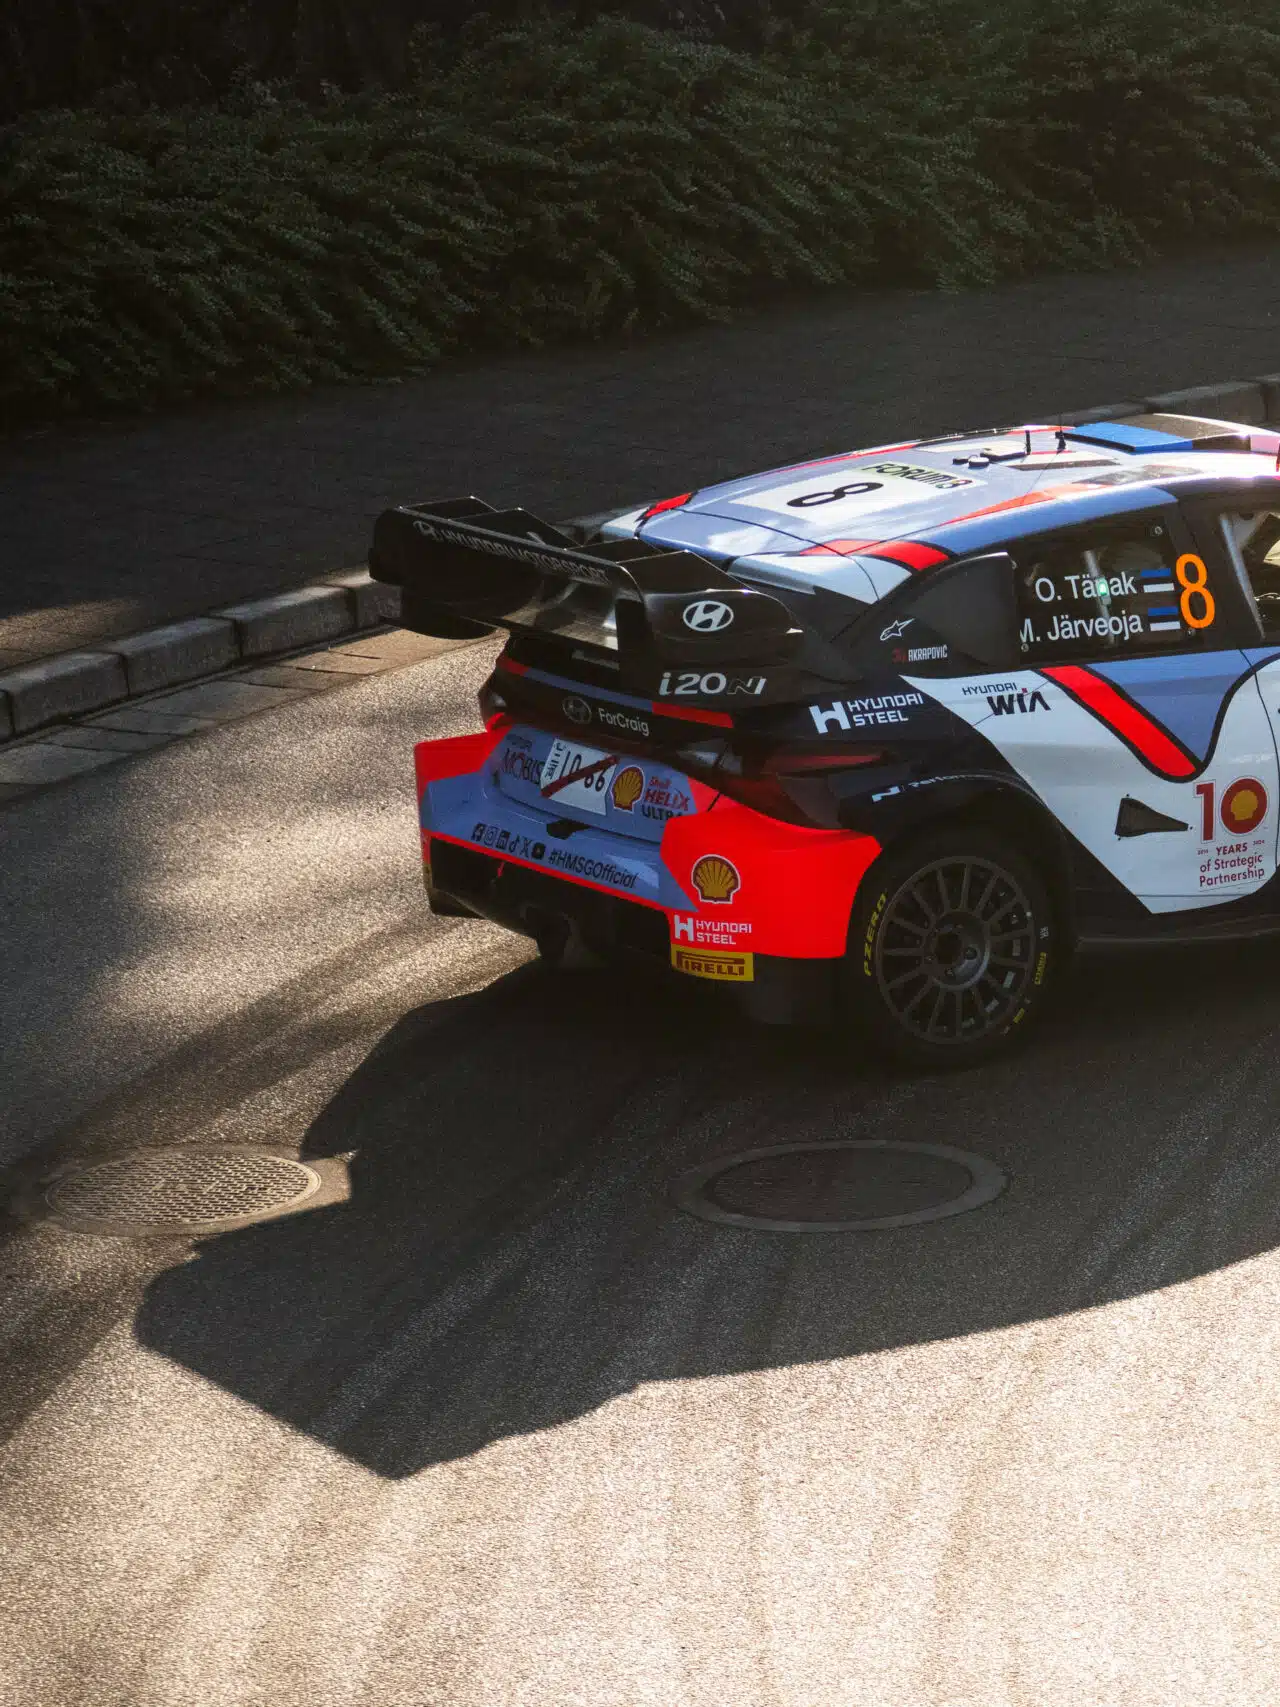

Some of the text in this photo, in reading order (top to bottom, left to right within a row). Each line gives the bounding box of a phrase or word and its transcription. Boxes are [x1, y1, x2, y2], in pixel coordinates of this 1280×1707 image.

[786, 482, 884, 508] 8
[1034, 576, 1062, 602] O.
[1175, 553, 1215, 629] 8
[1046, 609, 1144, 641] Järveoja
[849, 692, 924, 713] HYUNDAI
[961, 682, 1017, 697] HYUNDAI
[986, 688, 1052, 717] WIA
[598, 707, 650, 737] ForCraig
[852, 709, 909, 727] STEEL
[1195, 777, 1269, 842] 10
[1199, 852, 1264, 873] of Strategic
[1215, 842, 1248, 857] YEARS
[547, 849, 639, 889] #HMSGOfficial
[1199, 867, 1266, 889] Partnership
[695, 918, 752, 934] HYUNDAI
[695, 932, 737, 946] STEEL
[675, 951, 746, 977] PIRELLI
